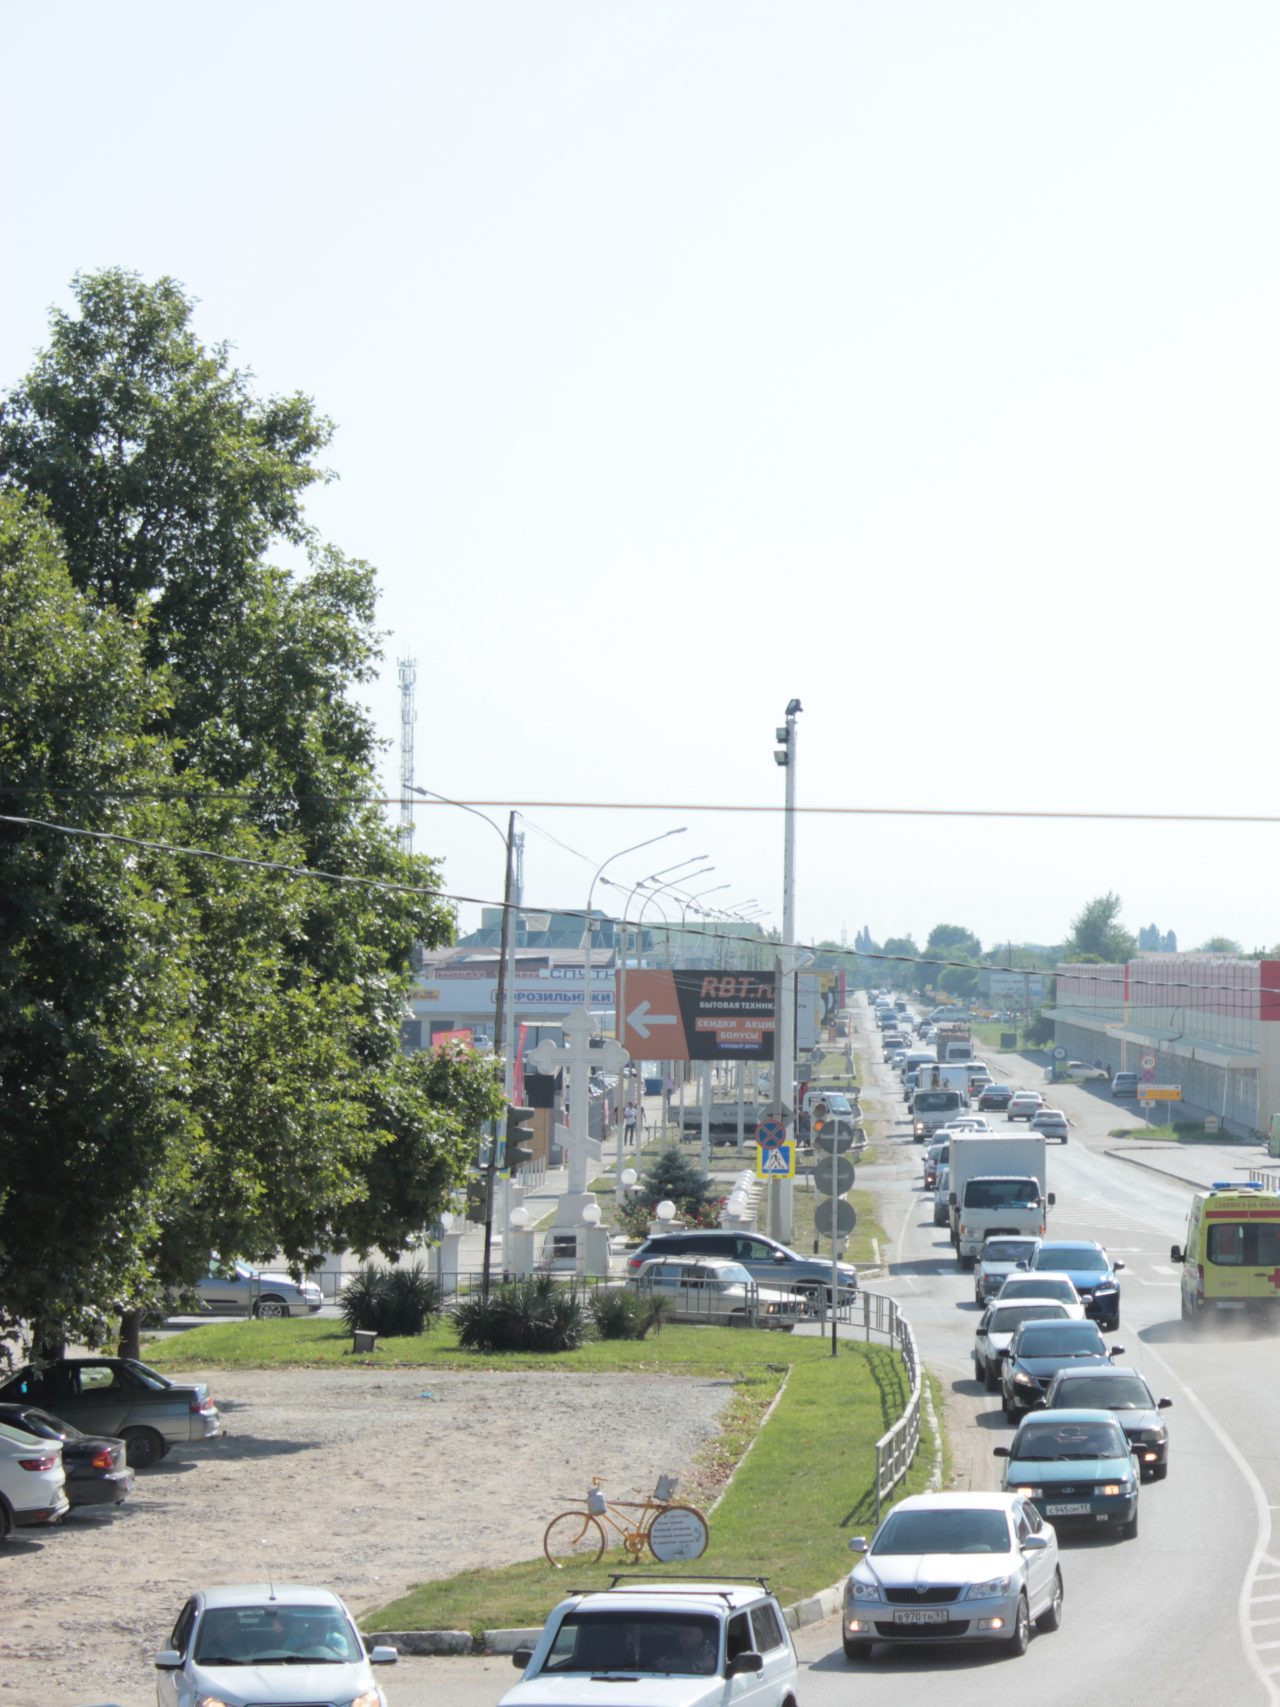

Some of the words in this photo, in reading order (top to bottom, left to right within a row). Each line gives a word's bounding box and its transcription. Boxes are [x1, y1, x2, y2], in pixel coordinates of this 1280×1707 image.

[700, 1001, 740, 1009] БЫТОВАЯ
[741, 1002, 775, 1010] ТЕХНИК
[698, 1020, 737, 1029] СКИДКИ
[720, 1031, 759, 1040] БОНУСЫ
